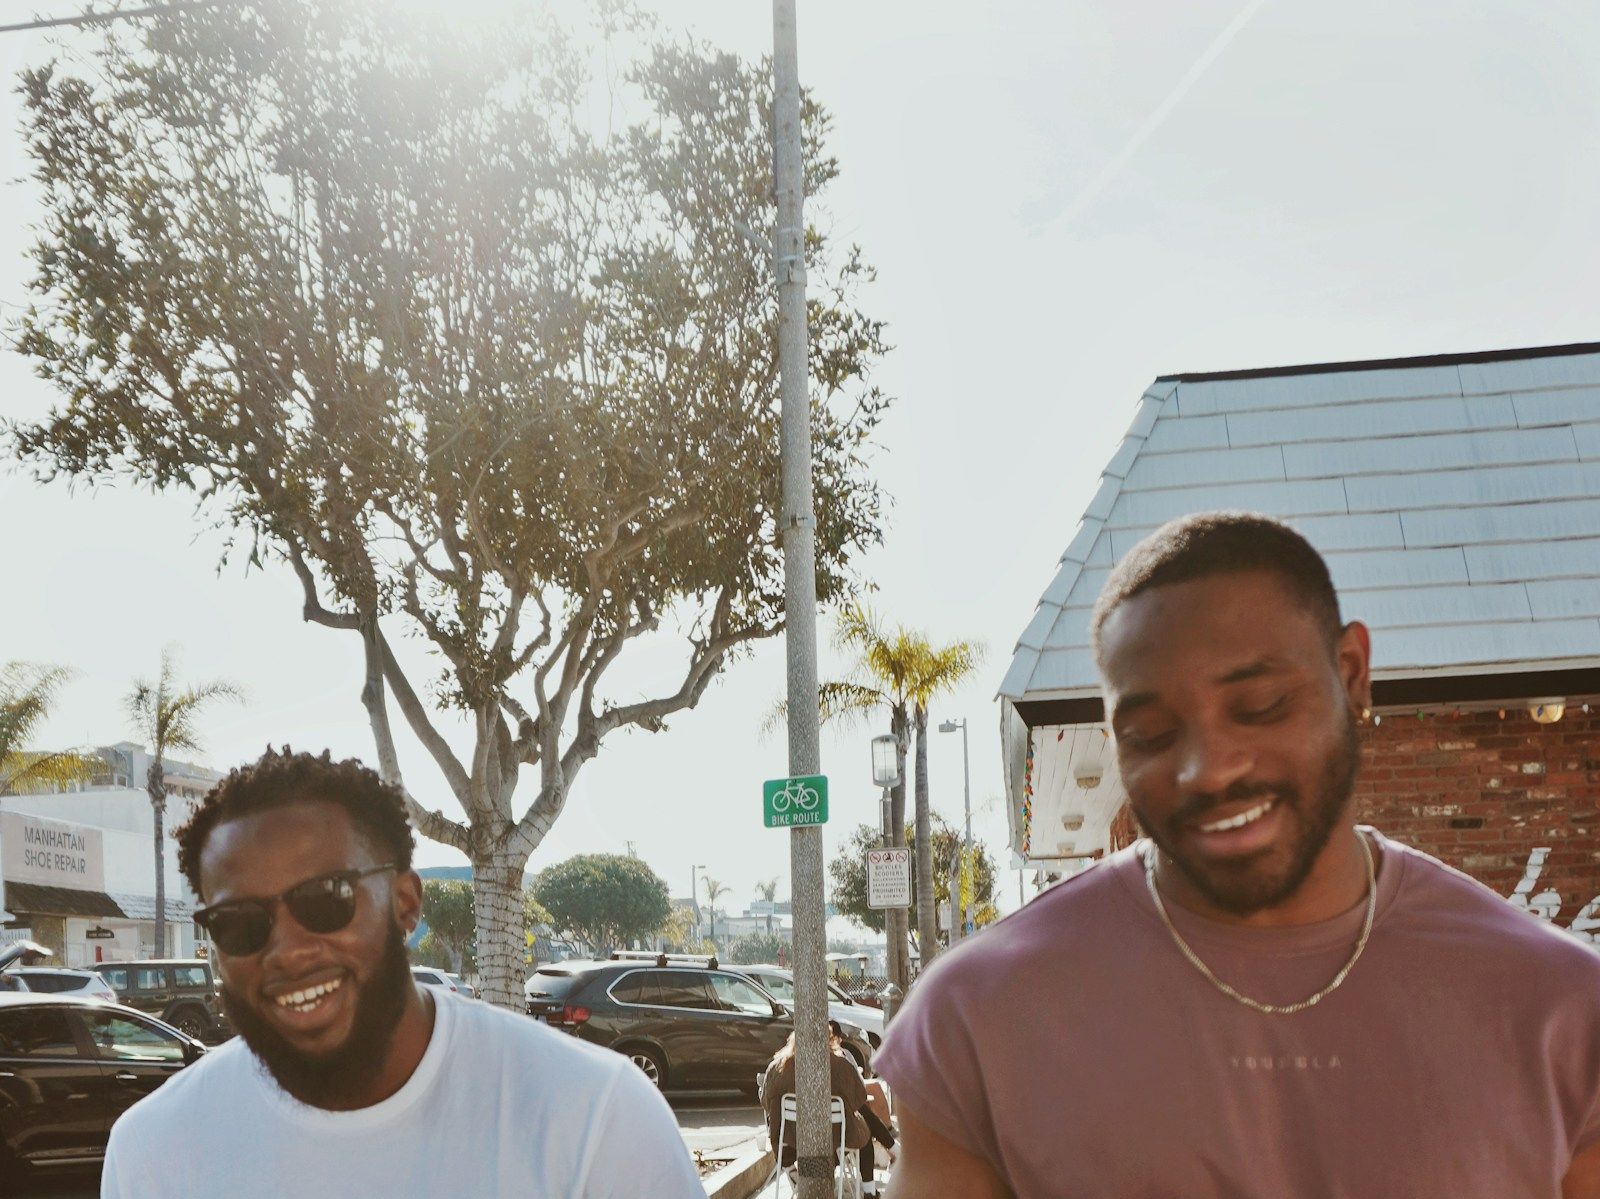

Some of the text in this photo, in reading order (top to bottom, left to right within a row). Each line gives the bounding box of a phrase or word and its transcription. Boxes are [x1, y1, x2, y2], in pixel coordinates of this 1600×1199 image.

[771, 812, 820, 825] BIKE ROUTE
[24, 826, 85, 852] MANHATTAN
[24, 849, 86, 874] SHOE REPAIR
